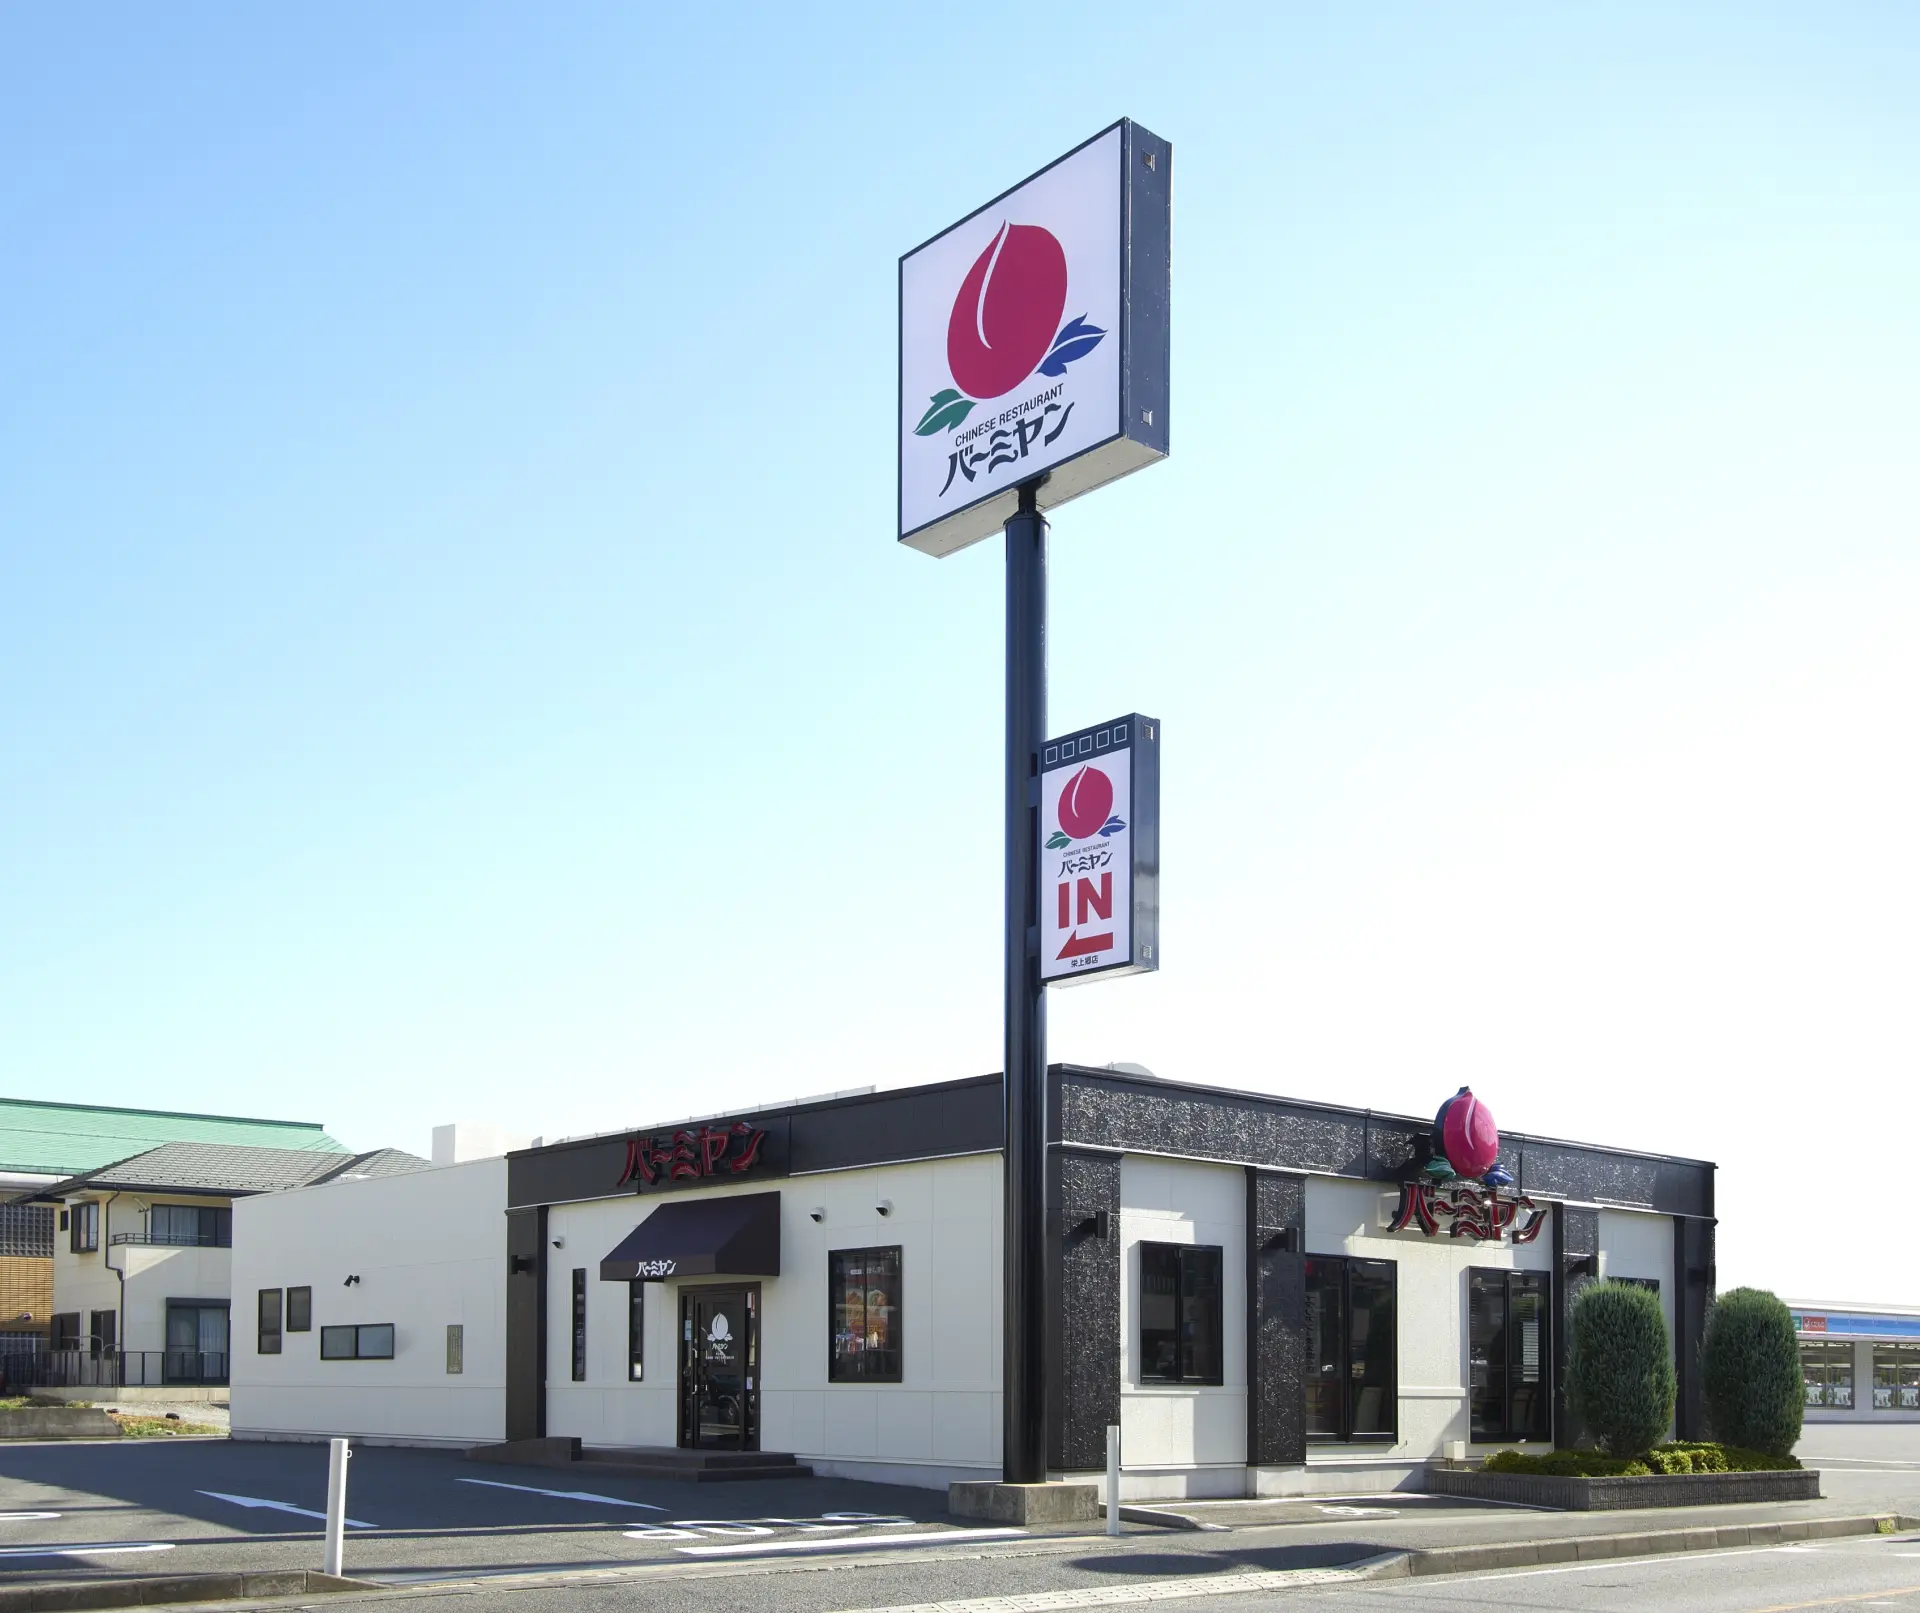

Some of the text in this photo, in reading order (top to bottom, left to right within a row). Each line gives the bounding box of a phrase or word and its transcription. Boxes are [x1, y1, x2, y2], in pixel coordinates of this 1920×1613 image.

[955, 383, 1065, 447] CHINESE RESTAURANT
[938, 401, 1076, 498] バーミヤン
[1057, 851, 1113, 878] バーミヤン
[1062, 841, 1110, 858] CHINESE RESTAURANT
[1058, 871, 1112, 929] IN
[616, 1121, 768, 1187] バーミヤン
[1386, 1181, 1547, 1244] バーミヤン
[636, 1259, 677, 1277] バーミヤン
[622, 1511, 916, 1540] STOP
